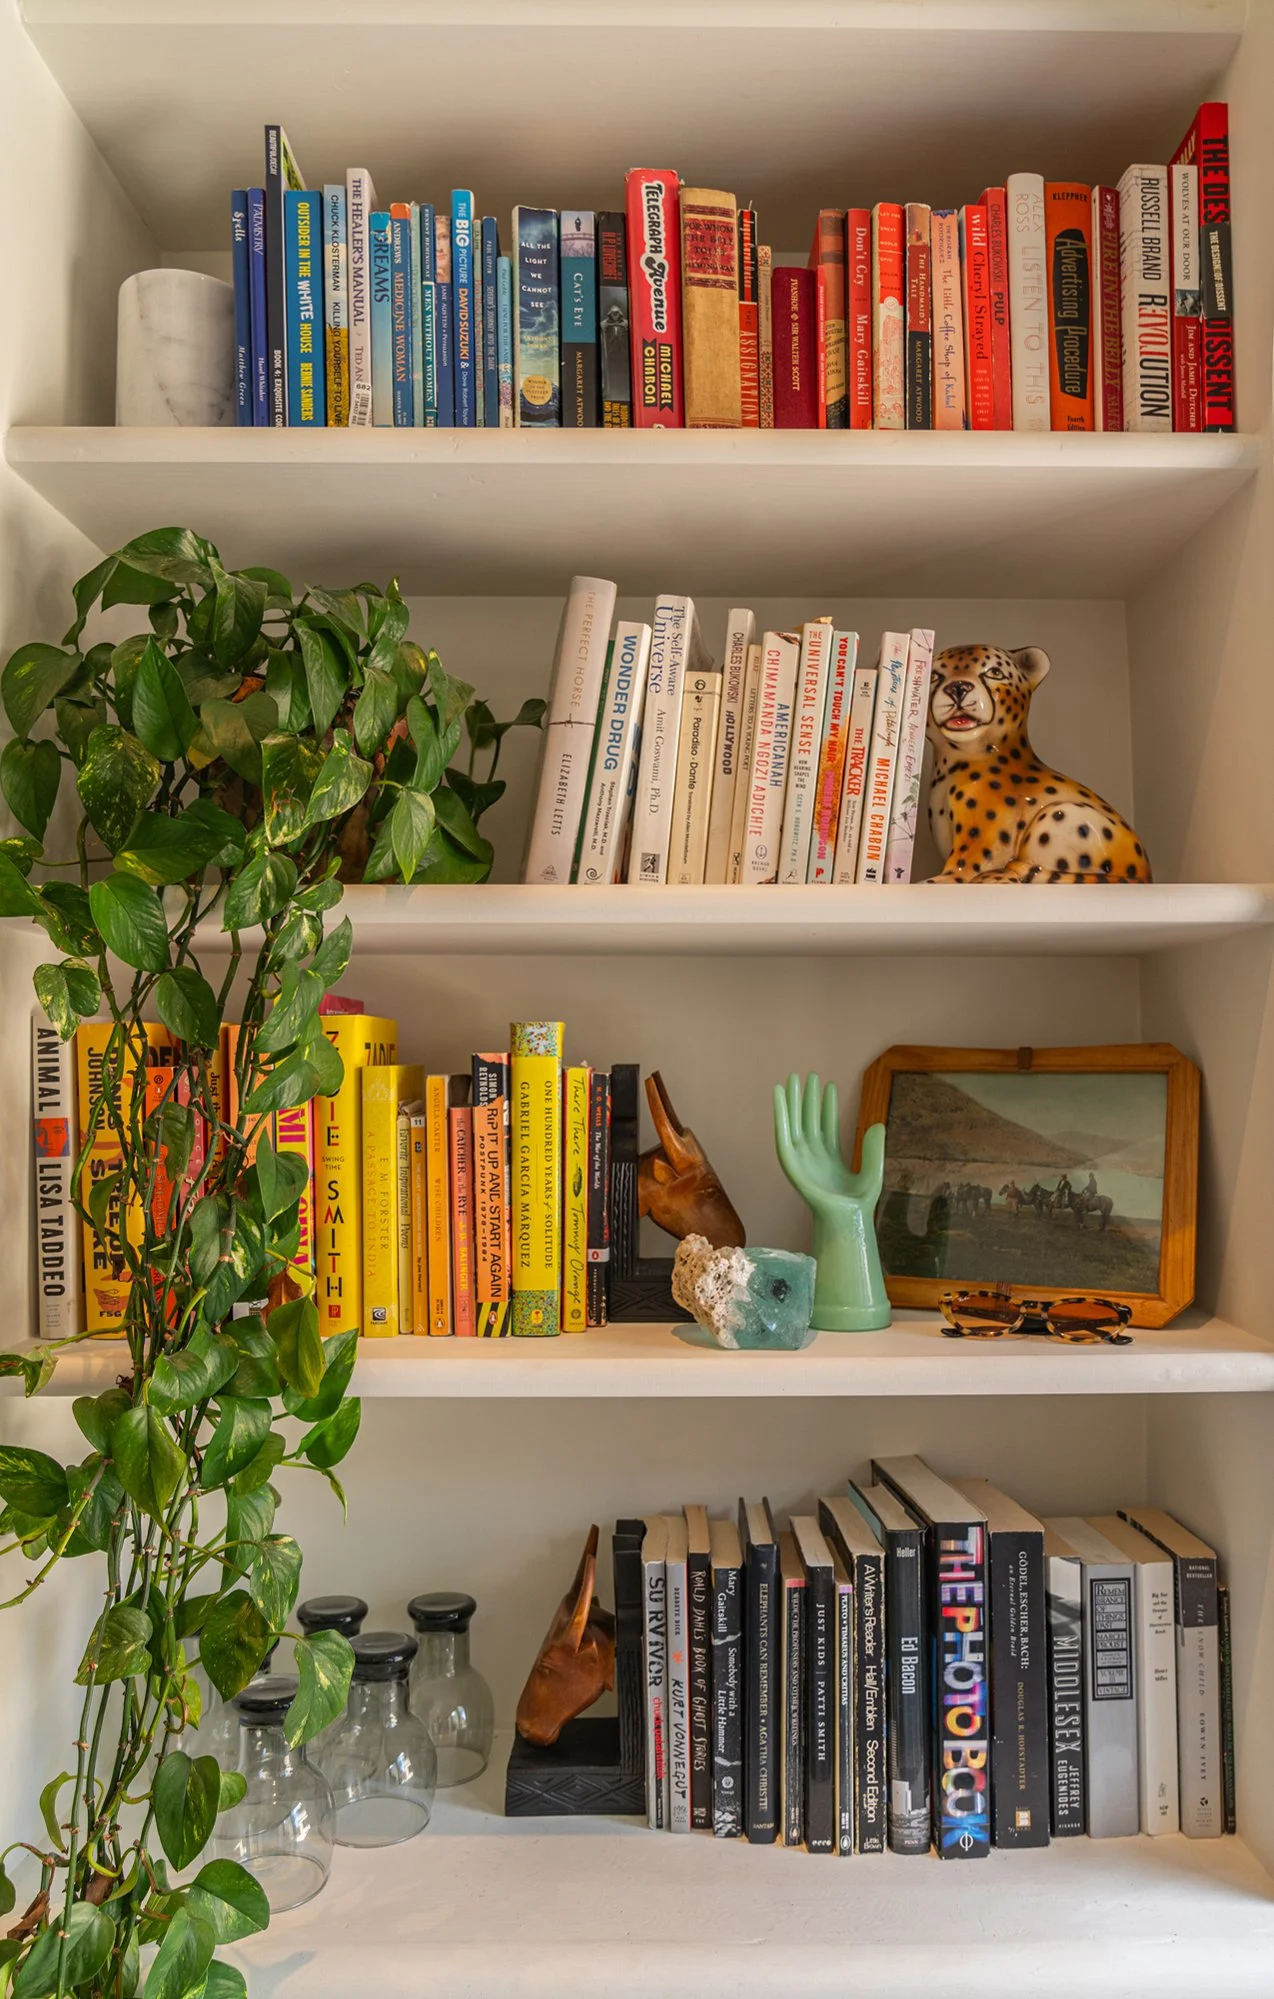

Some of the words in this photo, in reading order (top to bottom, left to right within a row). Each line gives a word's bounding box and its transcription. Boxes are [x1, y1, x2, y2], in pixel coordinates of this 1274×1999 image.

[1202, 135, 1229, 180] THE
[352, 179, 362, 199] THE
[1141, 177, 1161, 233] RUSSELL
[1181, 172, 1189, 211] WOLVES
[232, 211, 245, 241] Spells
[297, 202, 310, 246] OUTSIDER
[331, 195, 340, 227] CHUCK
[458, 203, 466, 217] THE
[645, 184, 662, 254] TELEGRAPH
[1182, 215, 1190, 225] AT
[352, 202, 365, 264] HEALER'S
[456, 219, 469, 246] BIG
[521, 242, 534, 250] ALL
[536, 242, 551, 250] THE
[855, 227, 867, 260] Don't
[972, 214, 986, 246] wild
[1182, 229, 1190, 248] OUR
[298, 261, 311, 277] THE
[299, 249, 310, 258] IN
[331, 230, 340, 291] KLOSTERMAN
[458, 249, 468, 283] PICTURE
[525, 257, 547, 265] LIGHT
[1142, 237, 1161, 280] BRAND
[1182, 252, 1191, 280] DOOR
[521, 285, 552, 294] CANNOT
[530, 272, 542, 280] WE
[853, 265, 867, 286] Cry
[970, 252, 986, 299] Cheryl
[1055, 238, 1087, 317] Advertising
[297, 281, 313, 320] WHITE
[353, 267, 365, 326] MANUAL
[392, 272, 406, 332] MEDICINE
[459, 288, 468, 321] DAVID
[646, 258, 666, 331] Avenue
[994, 292, 1005, 325] PULP
[300, 323, 311, 353] HOUSE
[332, 302, 341, 337] KILLING
[791, 323, 799, 334] SIR
[854, 314, 868, 345] Mary
[971, 305, 988, 359] Strayed
[395, 335, 406, 382] WOMAN
[459, 322, 468, 359] SUZUKI
[791, 336, 799, 365] WALTER
[300, 363, 312, 387] BERNIE
[333, 340, 341, 387] YOURSELF
[644, 347, 655, 404] CHABON
[660, 346, 671, 404] MICHAEL
[740, 331, 757, 420] ASSIGNATION
[857, 350, 868, 405] Gaitskill
[1055, 326, 1086, 393] Procedure
[1205, 317, 1232, 411] DISSENT
[334, 390, 341, 401] TO
[792, 367, 800, 390] SCOTT
[301, 389, 313, 420] SANDERS
[334, 404, 342, 425] LIVE
[673, 606, 685, 629] The
[649, 605, 673, 693] Universe
[666, 632, 683, 696] Self-Aware
[730, 632, 745, 664] CHARLES
[838, 637, 849, 656] YOU
[612, 635, 638, 714] WONDER
[726, 666, 741, 703] BUKOWSKI
[803, 641, 821, 708] UNIVERSAL
[835, 659, 846, 686] CAN'T
[759, 649, 781, 736] CHIMAMANDA
[832, 690, 843, 720] TOUCH
[656, 709, 666, 732] Amit
[800, 716, 814, 755] SENSE
[830, 723, 840, 737] MY
[604, 719, 624, 770] DRUG
[650, 736, 664, 784] Goswami,
[721, 710, 735, 774] HOLLYWOOD
[769, 703, 791, 787] AMERICANAH
[826, 740, 838, 763] HAIR
[555, 754, 572, 805] ELIZABETH
[754, 741, 770, 781] NGOZI
[847, 746, 865, 796] TRACKER
[872, 758, 890, 807] MICHAEL
[648, 787, 660, 816] Ph.D.
[749, 785, 766, 836] ADICHIE
[551, 808, 564, 835] LETTS
[867, 814, 884, 861] CHABON
[37, 1028, 60, 1112] ANIMAL
[478, 1067, 488, 1106] REYNOLDS
[488, 1073, 497, 1098] SIMON
[543, 1081, 552, 1102] ONE
[572, 1077, 585, 1113] There
[519, 1082, 530, 1139] GABRIEL
[456, 1129, 467, 1174] CATCHER
[488, 1132, 499, 1144] IT
[544, 1107, 553, 1161] HUNDRED
[572, 1119, 585, 1155] There
[488, 1150, 499, 1169] UP
[519, 1146, 532, 1196] GARCÍA
[39, 1164, 62, 1207] LISA
[488, 1172, 500, 1202] AND
[544, 1166, 553, 1199] YEARS
[457, 1195, 467, 1216] RYE
[489, 1205, 500, 1250] START
[519, 1202, 532, 1268] MÁRQUEZ
[544, 1214, 553, 1269] SOLITUDE
[568, 1205, 586, 1255] Tommy
[42, 1216, 66, 1297] TADDEO
[459, 1247, 469, 1290] SALINGER
[490, 1253, 501, 1297] AGAIN
[569, 1259, 583, 1304] Orange
[692, 1571, 706, 1601] ROALD
[724, 1571, 737, 1596] Mary
[865, 1565, 874, 1574] A
[717, 1593, 728, 1632] Gaitskill
[758, 1583, 768, 1637] ELEPHANTS
[864, 1573, 876, 1616] Writer's
[693, 1608, 706, 1639] DAHL'S
[817, 1604, 825, 1631] JUST
[1017, 1592, 1029, 1636] ESCHER,
[759, 1638, 768, 1658] CAN
[817, 1637, 825, 1666] KIDS
[865, 1617, 876, 1655] Reader
[901, 1637, 918, 1651] Ed
[1019, 1638, 1029, 1669] BACH:
[693, 1647, 706, 1673] BOOK
[725, 1647, 737, 1689] Somebody
[901, 1657, 919, 1694] Bacon
[671, 1679, 684, 1714] KURT
[694, 1679, 706, 1690] OF
[717, 1690, 727, 1716] Little
[728, 1690, 737, 1708] with
[759, 1660, 768, 1716] REMEMBER
[865, 1666, 879, 1730] Hall/Emblen
[1053, 1635, 1079, 1753] MIDDLESEX
[652, 1697, 664, 1726] chuck
[693, 1697, 707, 1731] GHOST
[694, 1737, 707, 1771] STORIES
[717, 1718, 727, 1753] Hammer
[759, 1725, 769, 1765] AGATHA
[818, 1721, 826, 1760] SMITH
[672, 1723, 687, 1798] VONNEGUT
[866, 1740, 879, 1783] Second
[759, 1769, 769, 1811] CHRISTIE
[866, 1786, 879, 1822] Edition
[1057, 1760, 1069, 1815] EUGENIDES
[1069, 1765, 1079, 1808] JEFFREY
